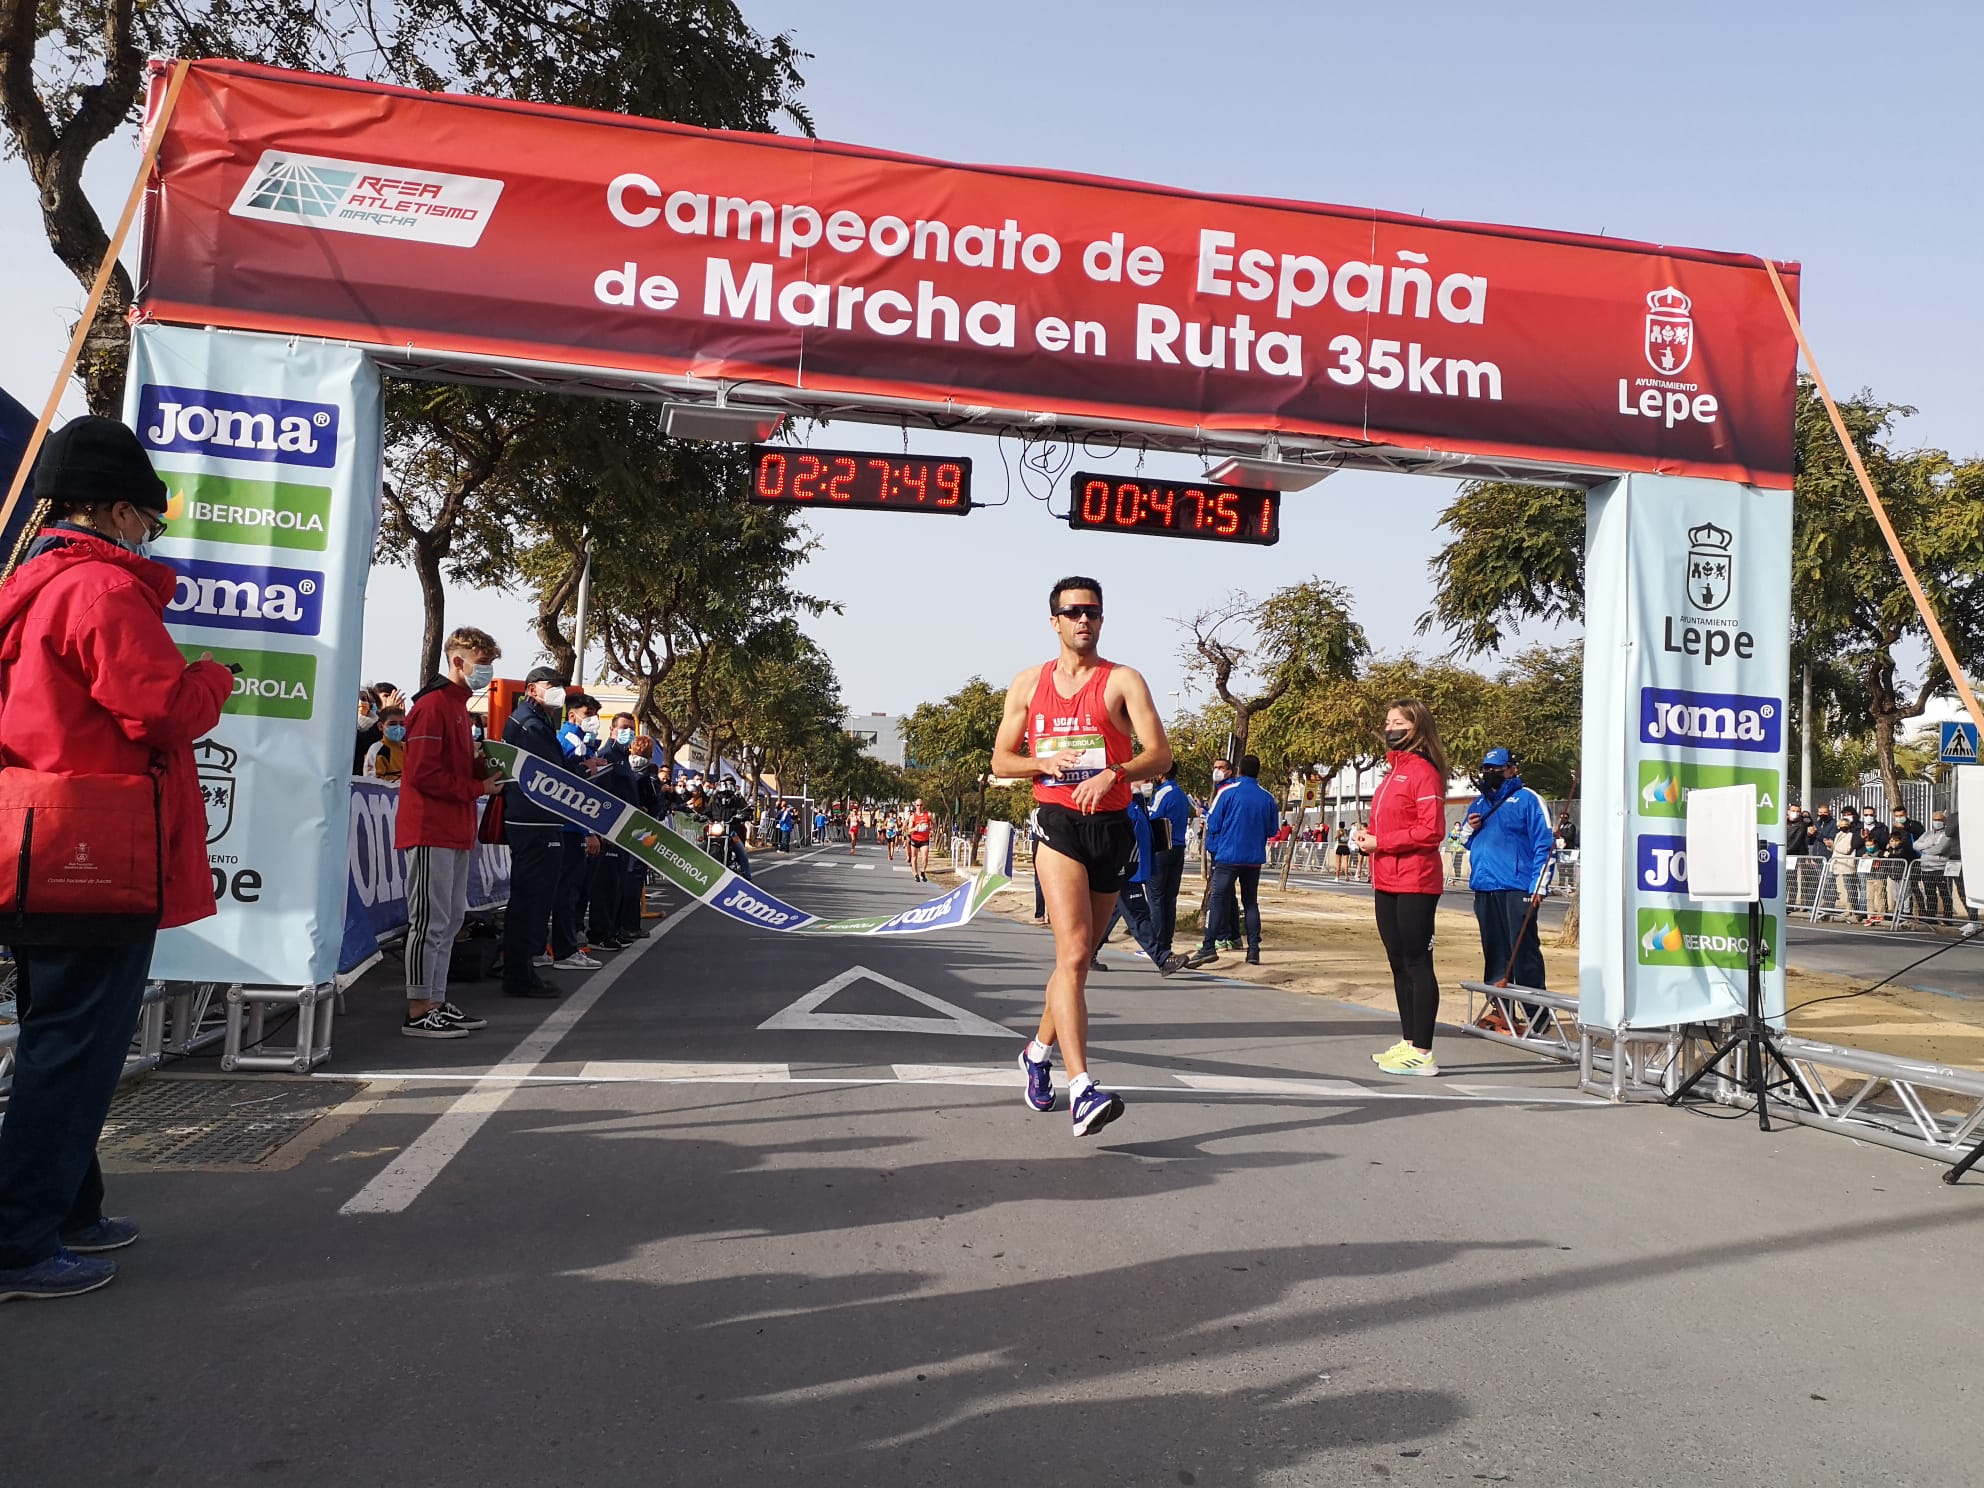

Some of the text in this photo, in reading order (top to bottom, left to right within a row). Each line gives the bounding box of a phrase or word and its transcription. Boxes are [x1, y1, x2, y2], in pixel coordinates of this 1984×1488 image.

[357, 175, 443, 199] RFEA
[338, 209, 418, 228] MARCHA
[348, 194, 479, 221] ATLETISMO
[606, 172, 1488, 325] Campeonato de España
[593, 256, 1503, 401] de Marcha en Ruta 35km
[1635, 377, 1698, 391] AYUNTAMIENTO
[1618, 378, 1719, 429] Lepe
[757, 452, 962, 506] 02:27:49
[188, 500, 324, 533] IBERDROLA
[1083, 480, 1270, 535] 00:47:51
[1679, 615, 1739, 627] AYUNTAMIENTO
[1664, 615, 1755, 666] Lepe
[231, 676, 308, 700] DROLA
[653, 842, 709, 886] IBERDROLA
[1683, 934, 1769, 953] IBERDROA
